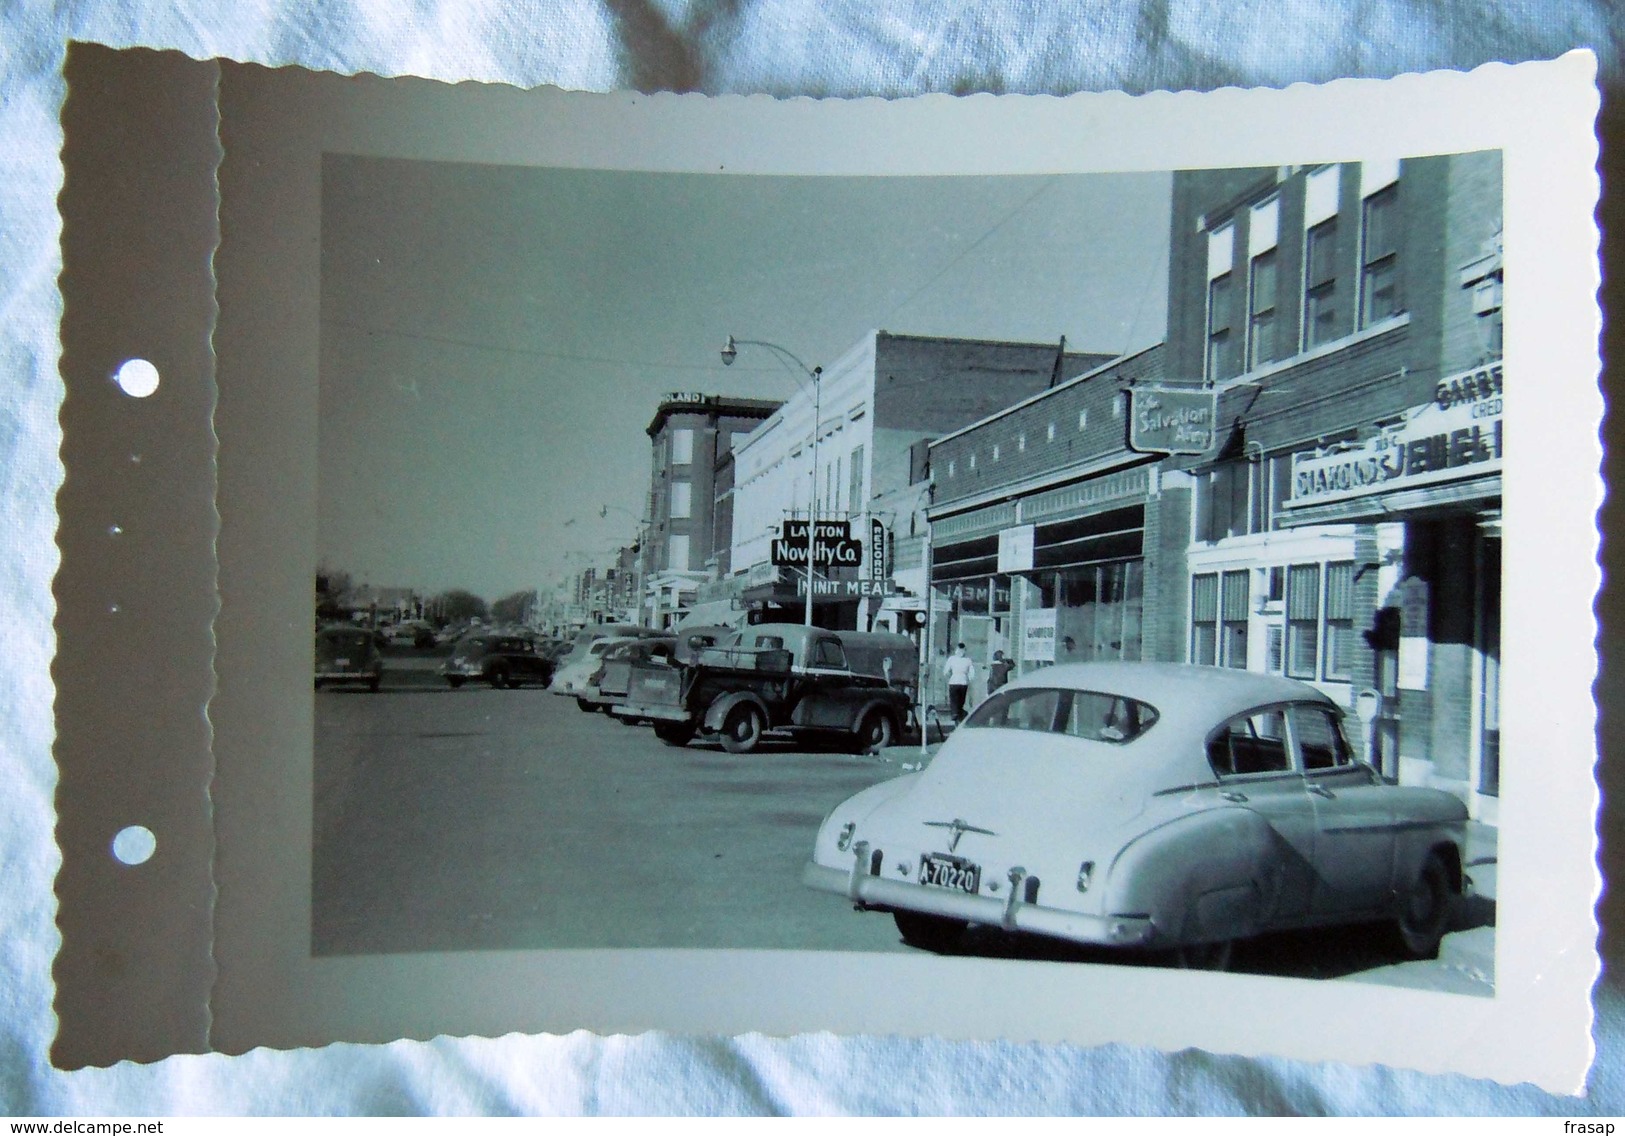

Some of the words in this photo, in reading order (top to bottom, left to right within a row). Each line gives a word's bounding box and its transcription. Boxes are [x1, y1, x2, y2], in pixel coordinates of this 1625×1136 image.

[1139, 407, 1208, 434] Salvation
[836, 541, 857, 562] Co.
[873, 526, 883, 580] RECORD
[846, 580, 893, 595] MEAL
[920, 862, 974, 891] A-70220
